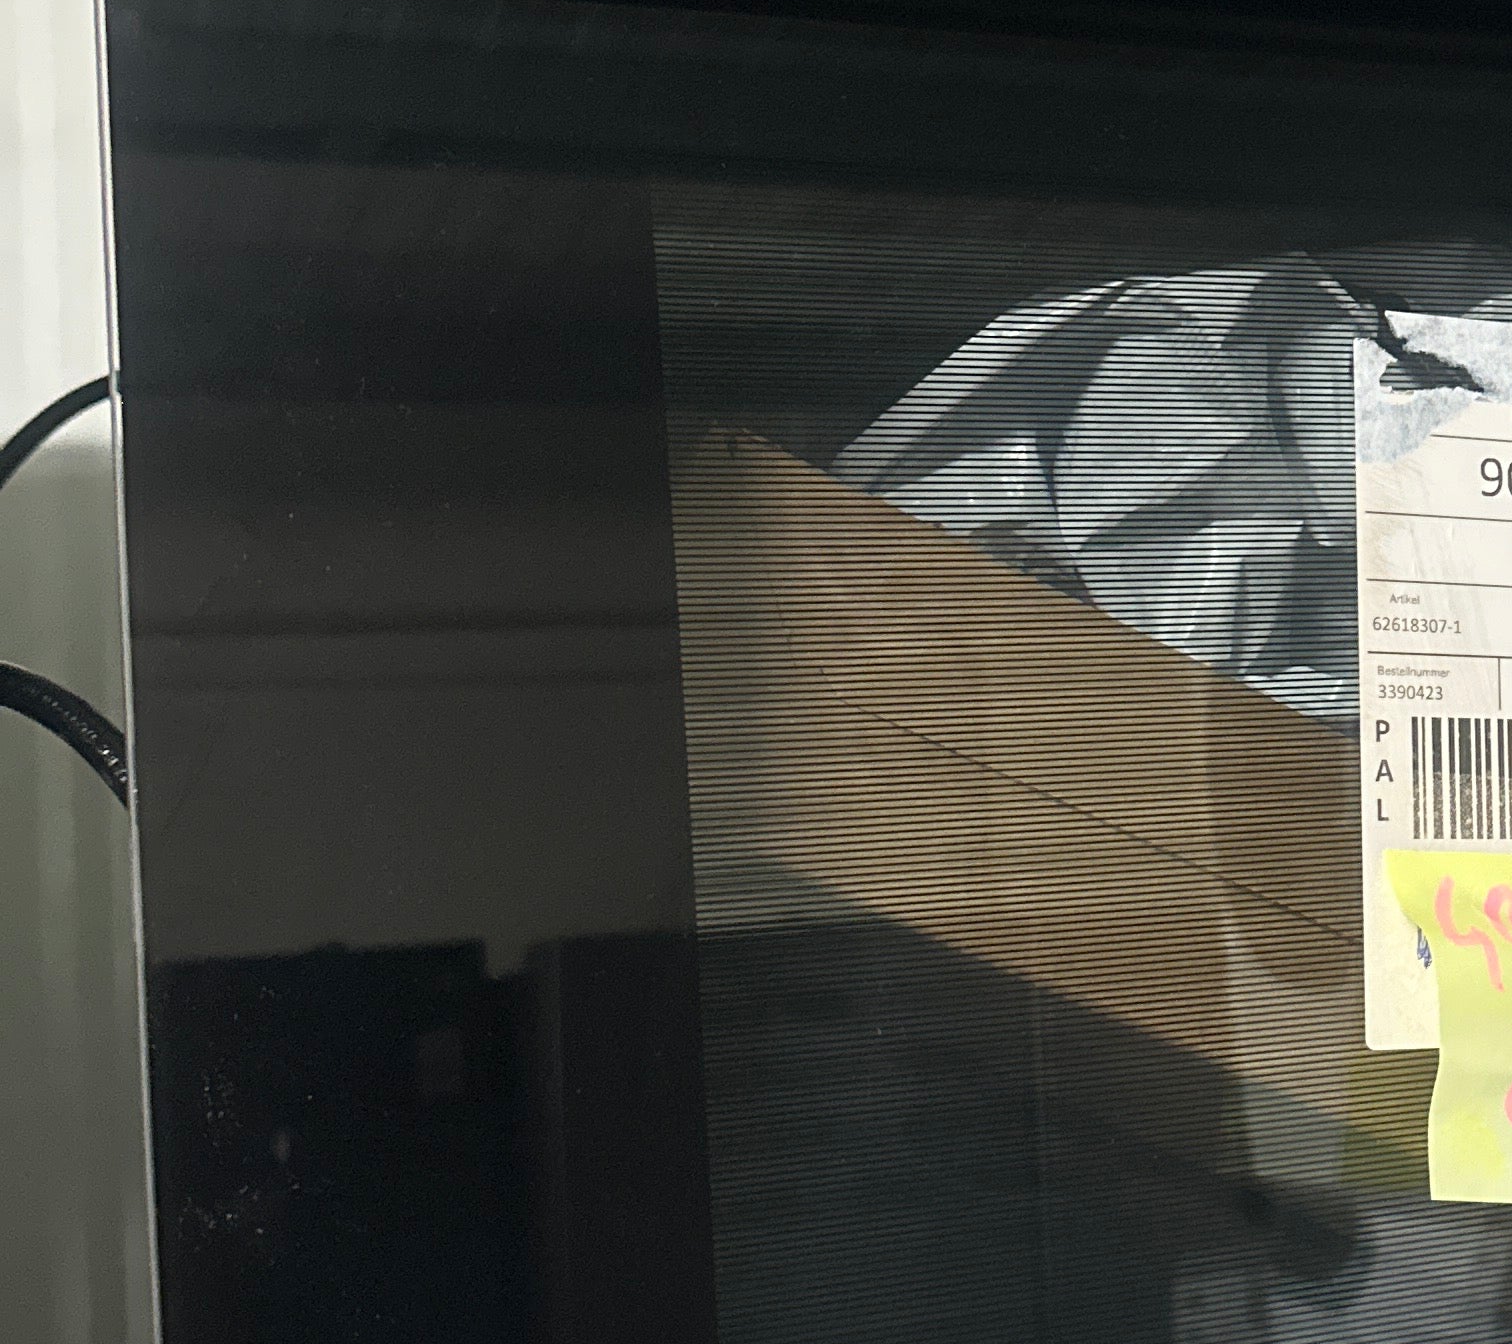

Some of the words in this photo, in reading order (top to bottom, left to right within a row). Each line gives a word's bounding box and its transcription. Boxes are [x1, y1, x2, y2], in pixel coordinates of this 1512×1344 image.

[1389, 593, 1421, 605] Artikel
[1372, 616, 1462, 635] 62618307-1
[1377, 666, 1450, 679] Bestellnummer
[1378, 684, 1443, 701] 3390423
